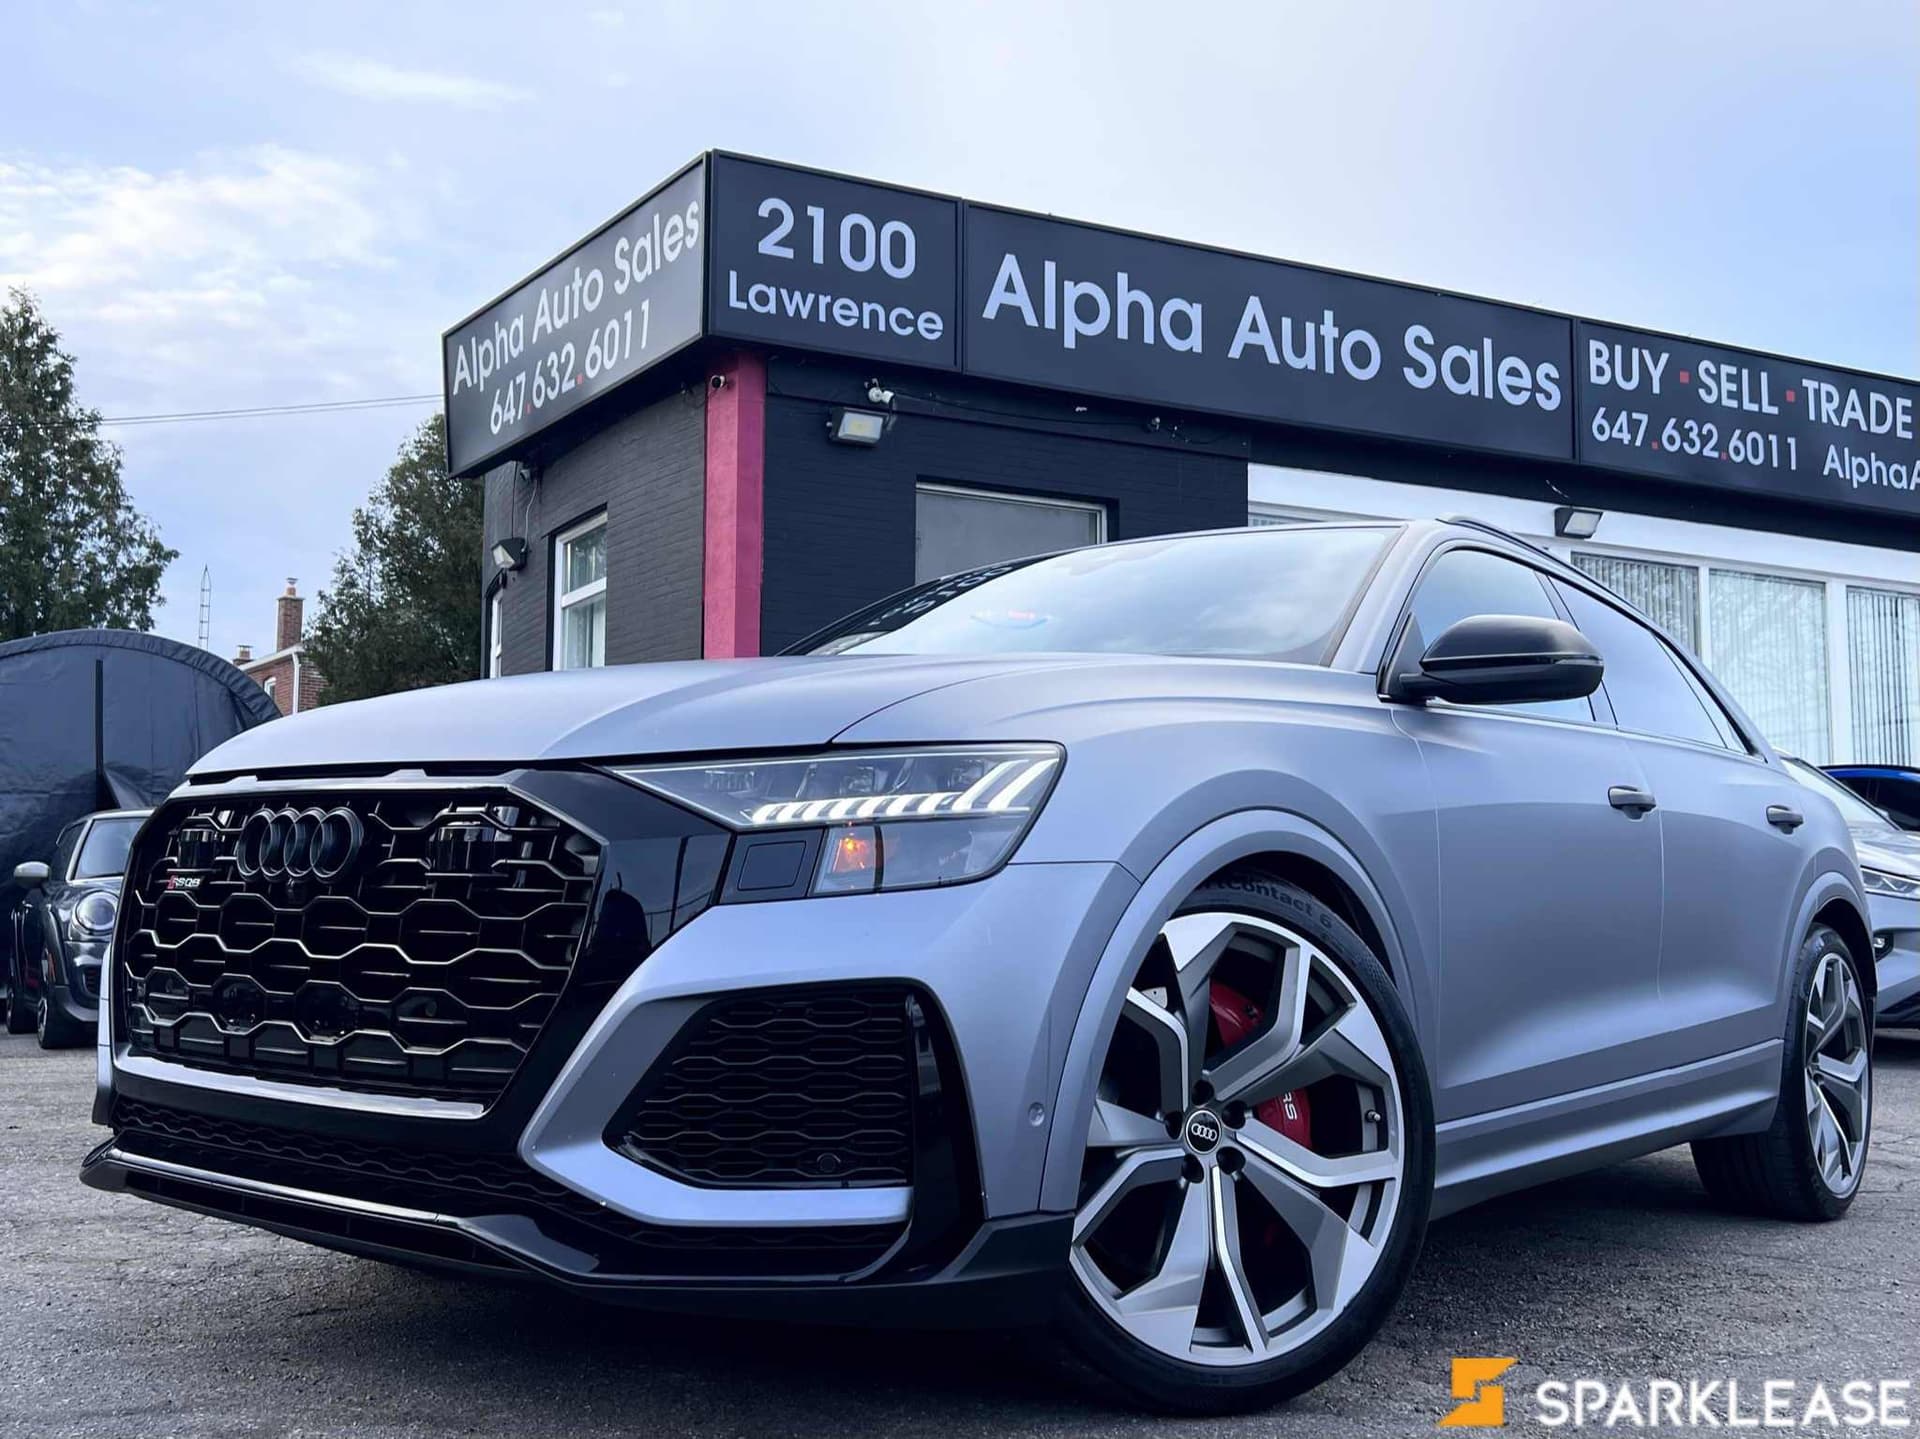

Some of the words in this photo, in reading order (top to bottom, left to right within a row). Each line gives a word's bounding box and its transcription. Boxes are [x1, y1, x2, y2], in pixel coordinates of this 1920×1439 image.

[757, 198, 916, 280] 2100
[453, 312, 524, 395] Alpha
[532, 266, 603, 343] Auto
[613, 201, 699, 296] Sales
[729, 270, 943, 340] Lawrence
[982, 253, 1203, 353] Alpha
[1228, 295, 1381, 381] Auto
[1403, 324, 1561, 411] Sales
[490, 299, 649, 435] 647.632.6011
[1589, 339, 1669, 394] BUY
[1698, 360, 1779, 415] SELL
[1802, 378, 1913, 440] TRADE
[1591, 407, 1797, 470] 647.632.6011
